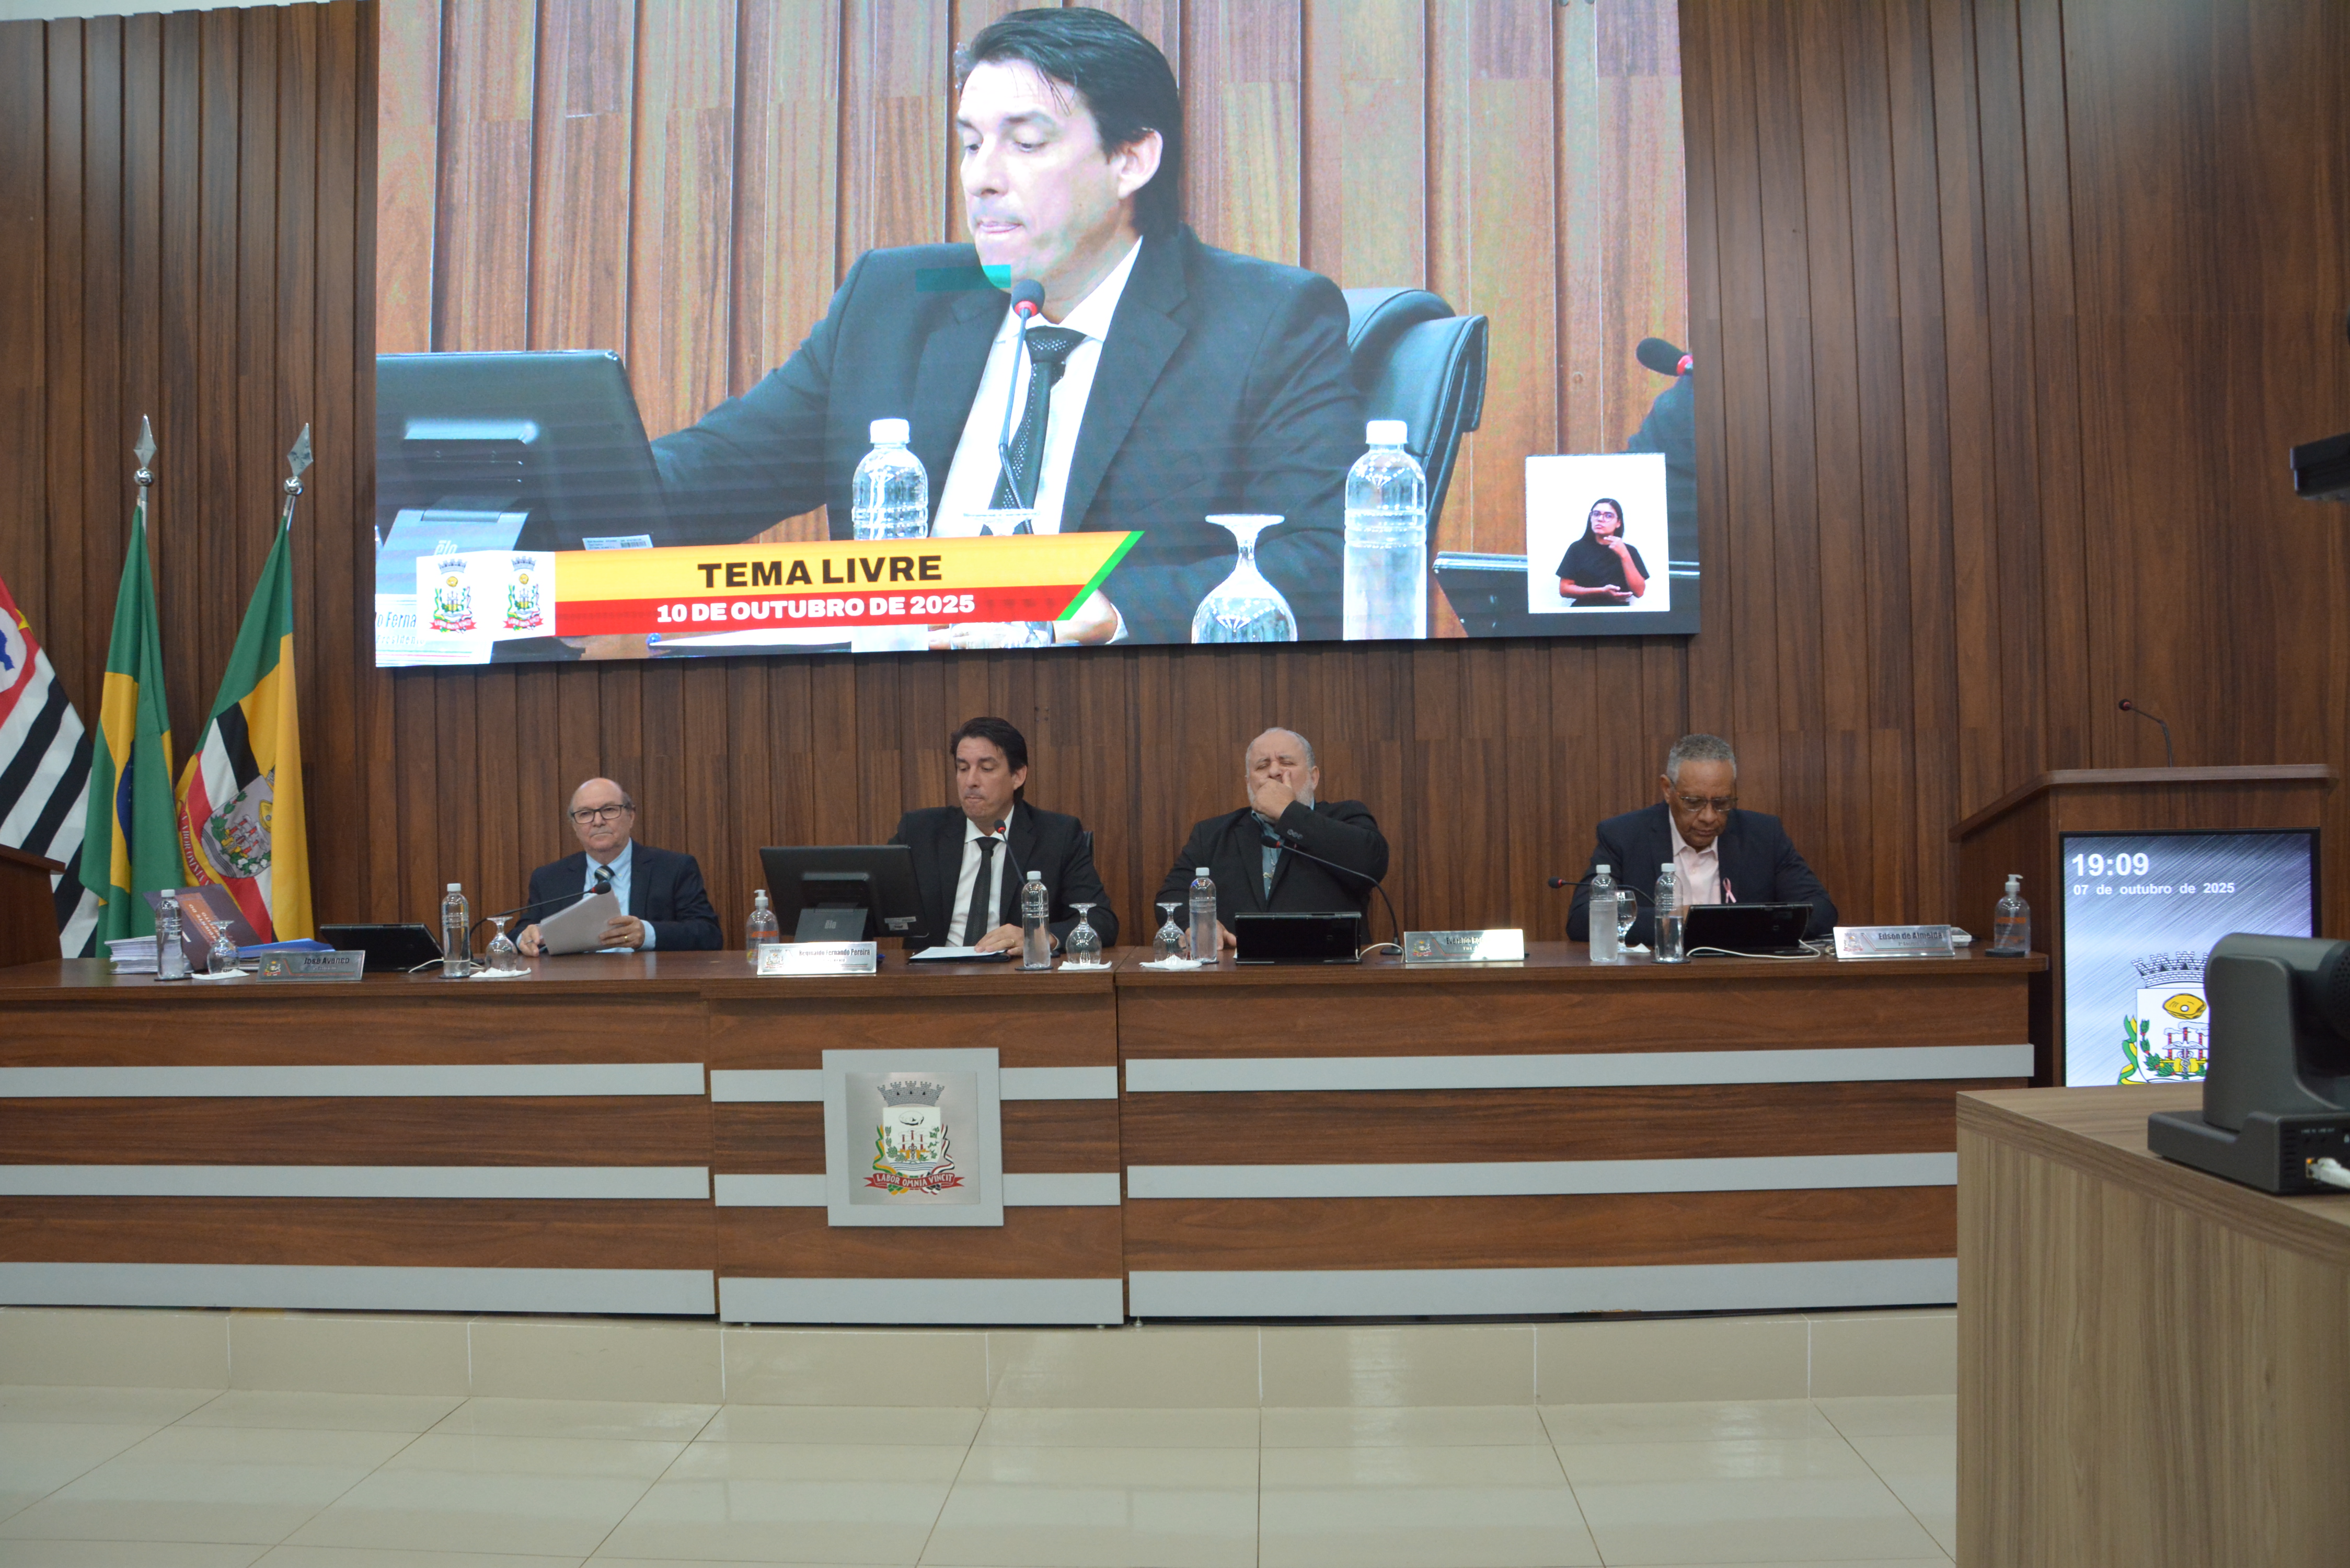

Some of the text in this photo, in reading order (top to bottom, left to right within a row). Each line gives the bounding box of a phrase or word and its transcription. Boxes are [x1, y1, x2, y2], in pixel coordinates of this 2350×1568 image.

[697, 555, 942, 588] TEMA LIVRE
[657, 595, 975, 622] 10 DE OUTUBRO DE 2025
[2072, 852, 2149, 877] 19:09
[2073, 882, 2235, 895] 07 de outubro de 2025
[1913, 931, 1943, 940] Almeida
[877, 1173, 954, 1187] LABOR OMNIA VINCIT
